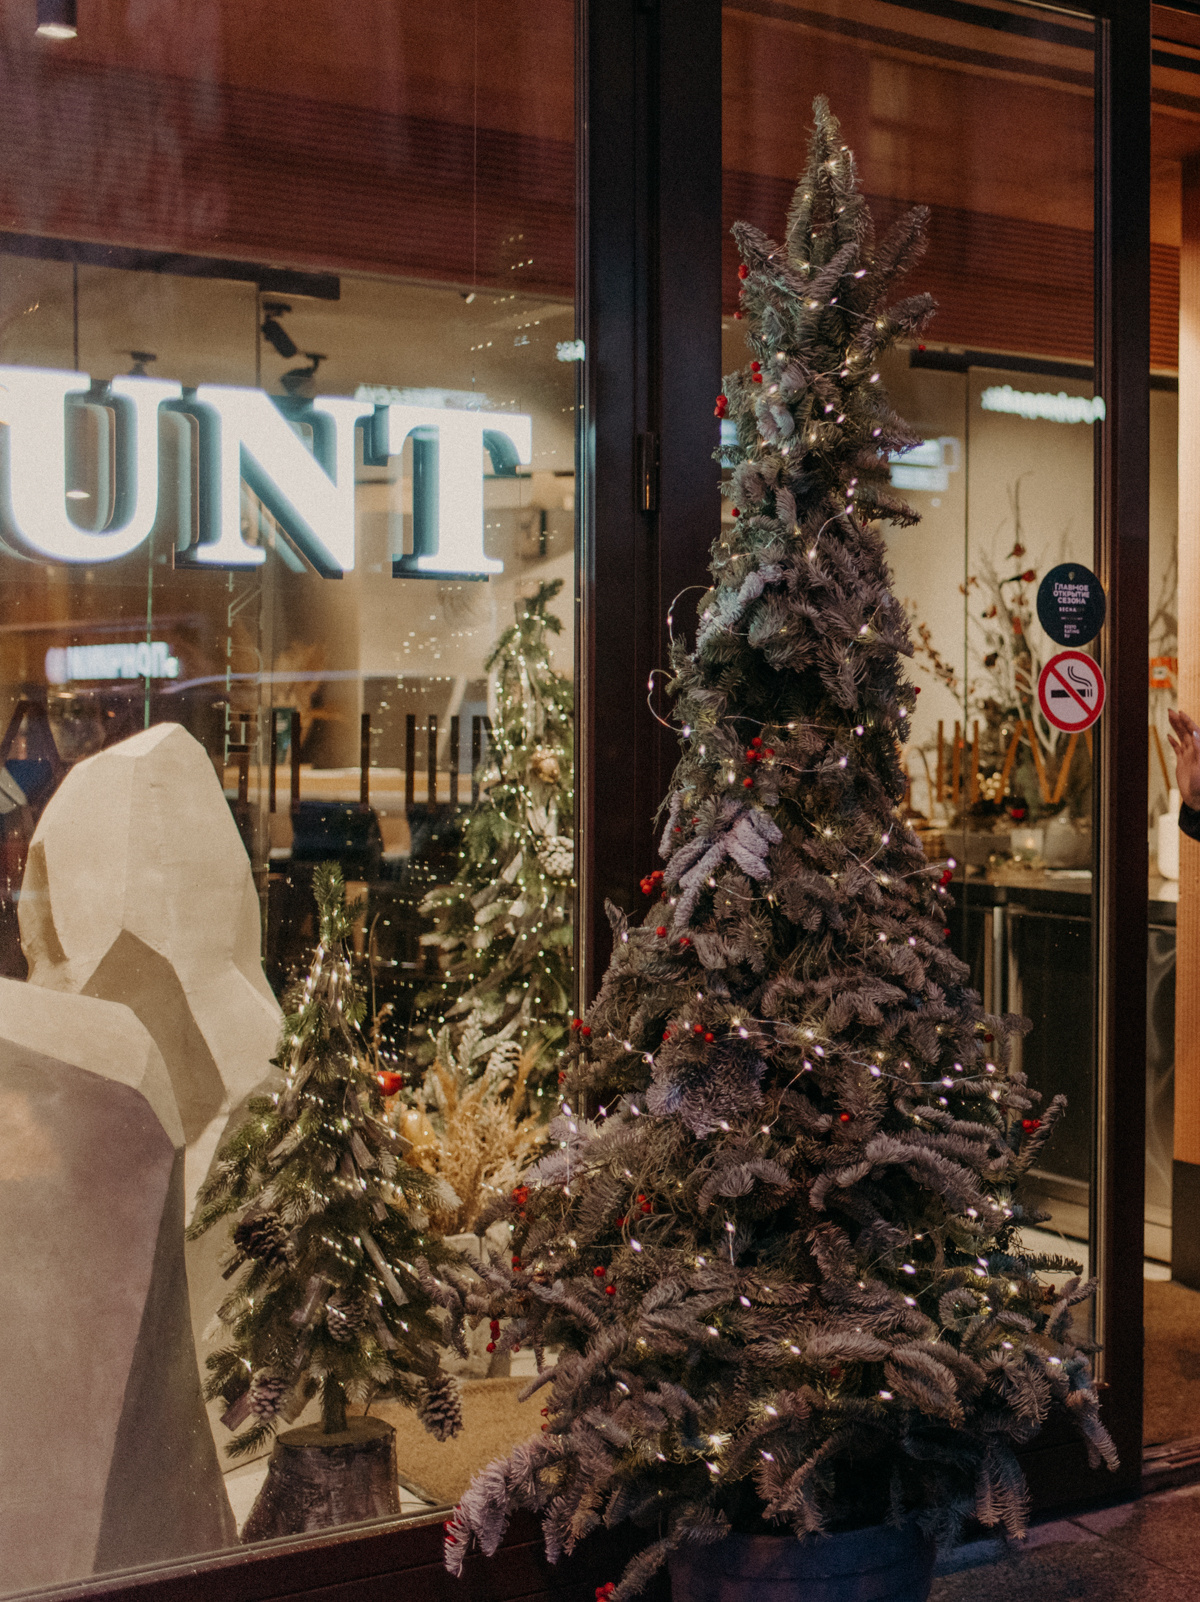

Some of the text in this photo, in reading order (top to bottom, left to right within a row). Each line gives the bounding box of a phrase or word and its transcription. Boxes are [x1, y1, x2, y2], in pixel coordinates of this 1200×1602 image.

[0, 364, 532, 575] UNT
[1053, 590, 1090, 598] ОТКРЫТИЕ
[1057, 597, 1086, 605] СЕЗОНА
